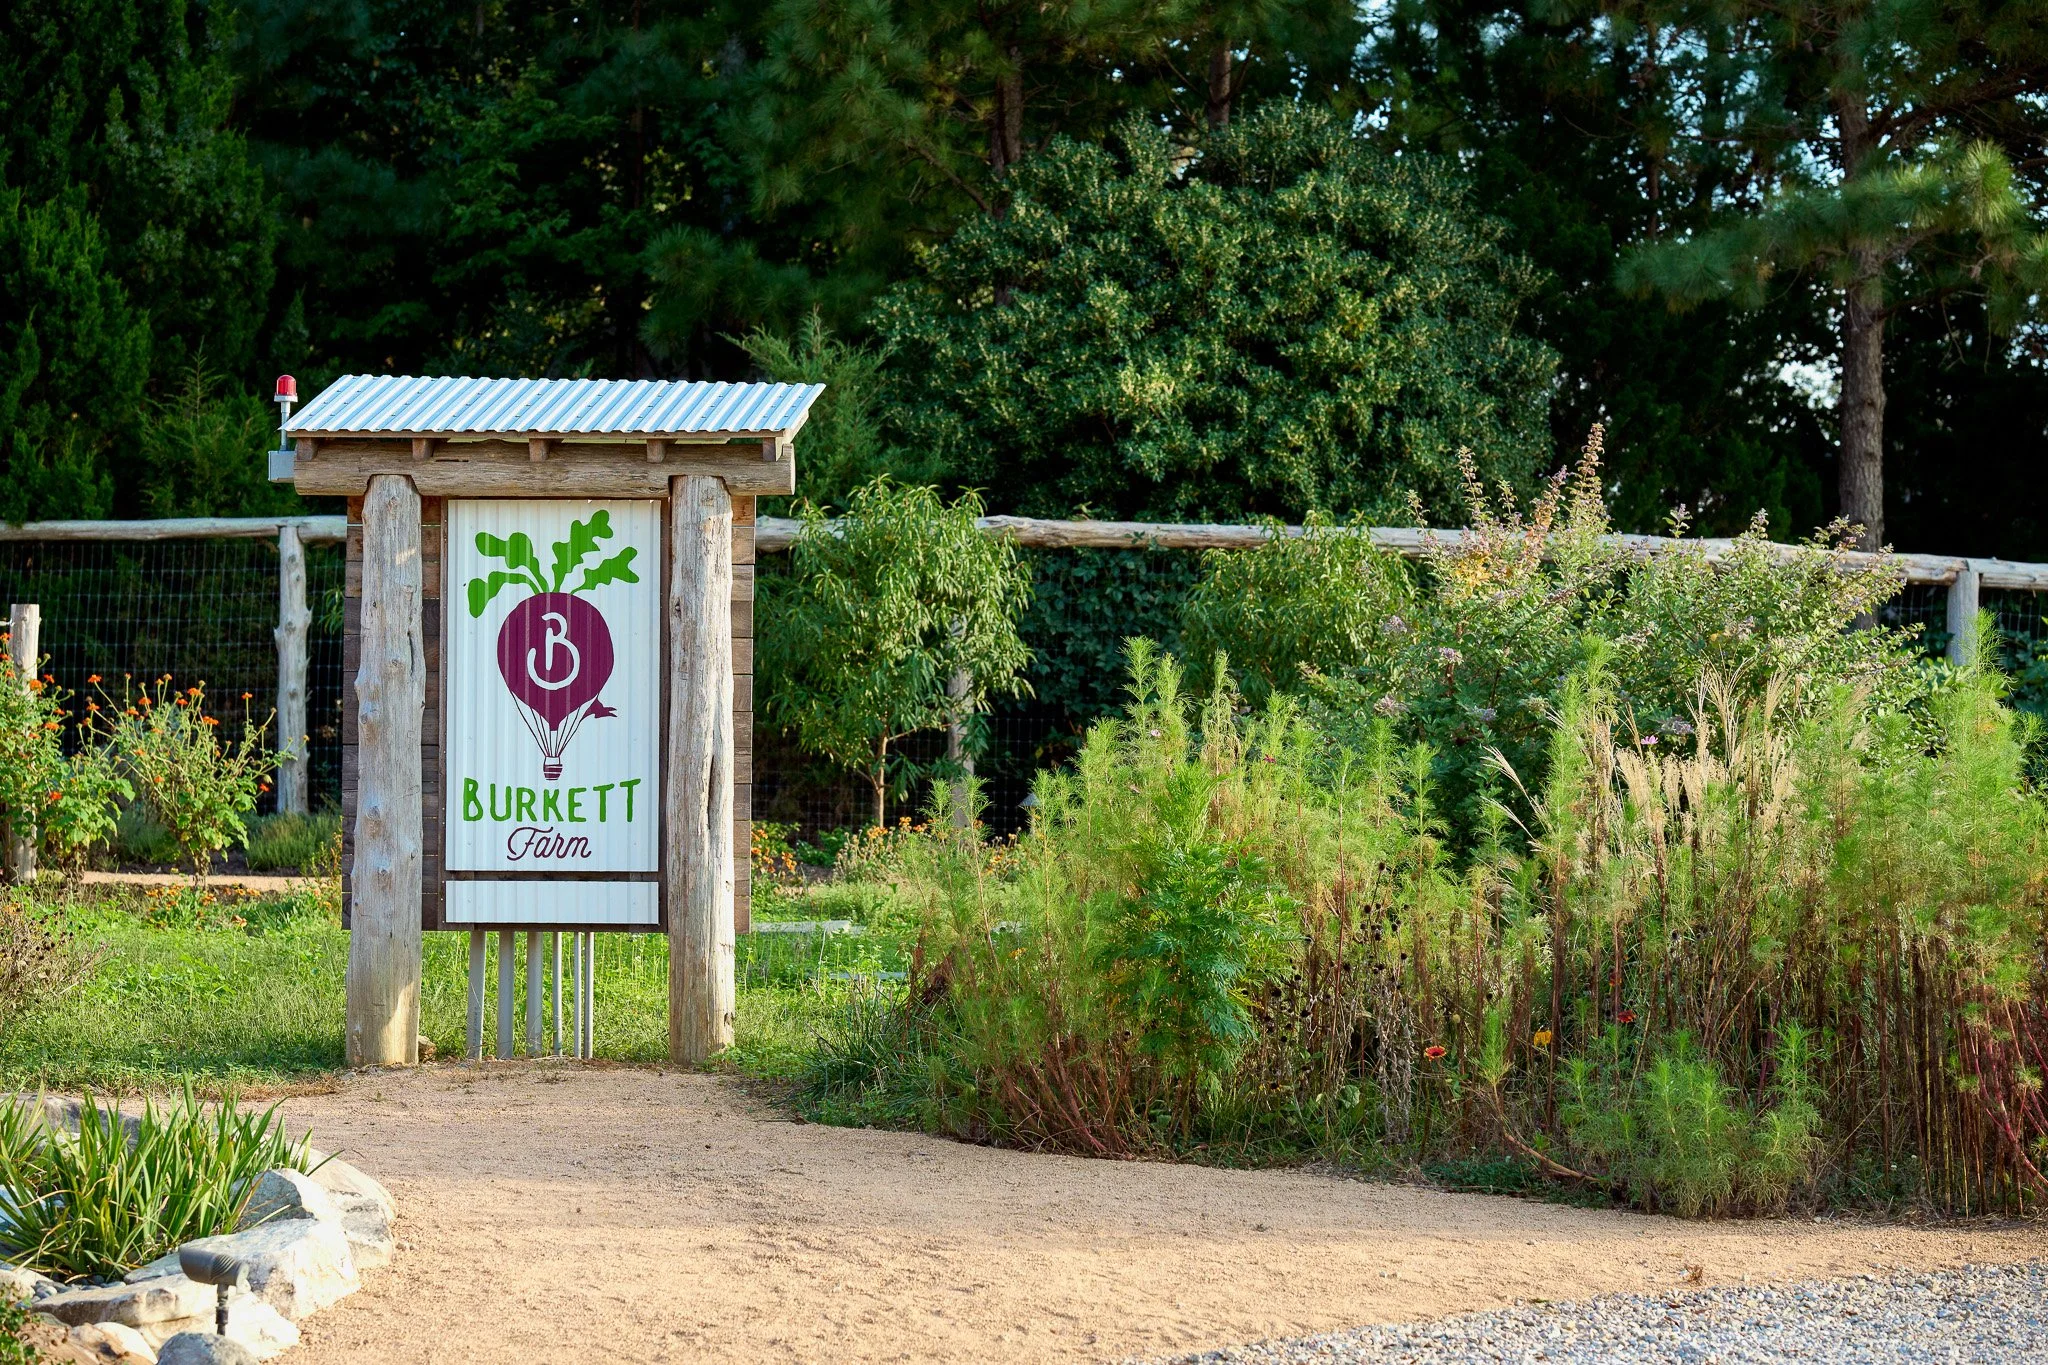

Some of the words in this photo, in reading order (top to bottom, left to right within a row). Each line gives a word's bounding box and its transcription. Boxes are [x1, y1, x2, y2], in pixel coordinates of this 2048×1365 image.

[527, 612, 580, 690] B
[463, 777, 641, 822] BURKETT
[507, 826, 592, 861] Farm
